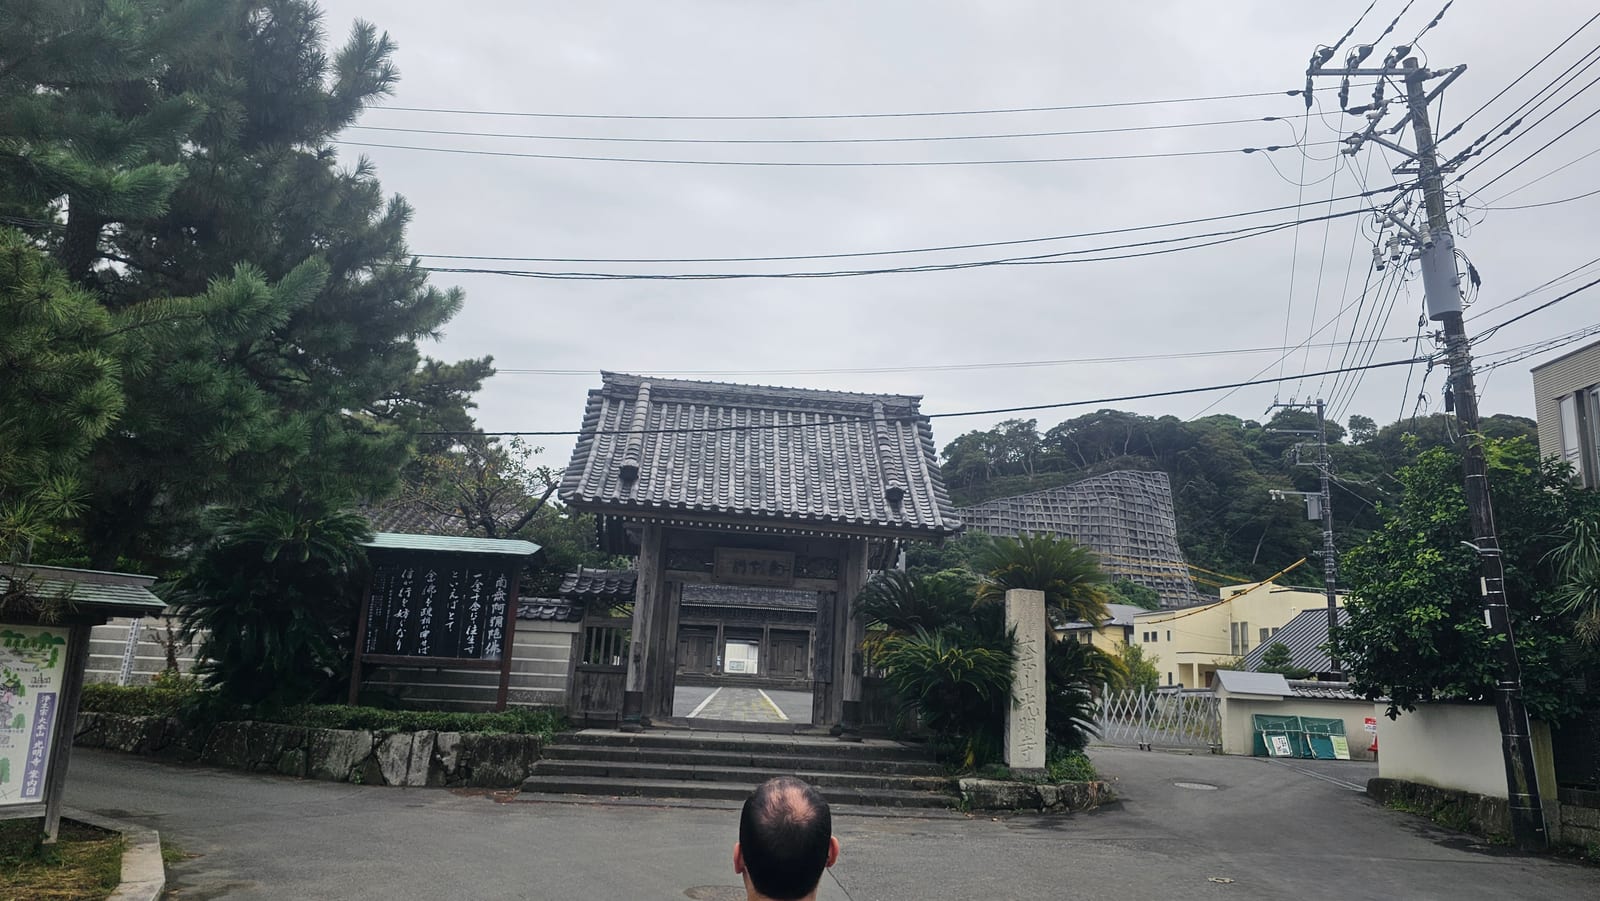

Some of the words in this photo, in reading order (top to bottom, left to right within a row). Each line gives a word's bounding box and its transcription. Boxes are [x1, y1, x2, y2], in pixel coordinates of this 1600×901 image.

[36, 717, 48, 738] 大本山
[31, 741, 45, 767] 光明寺
